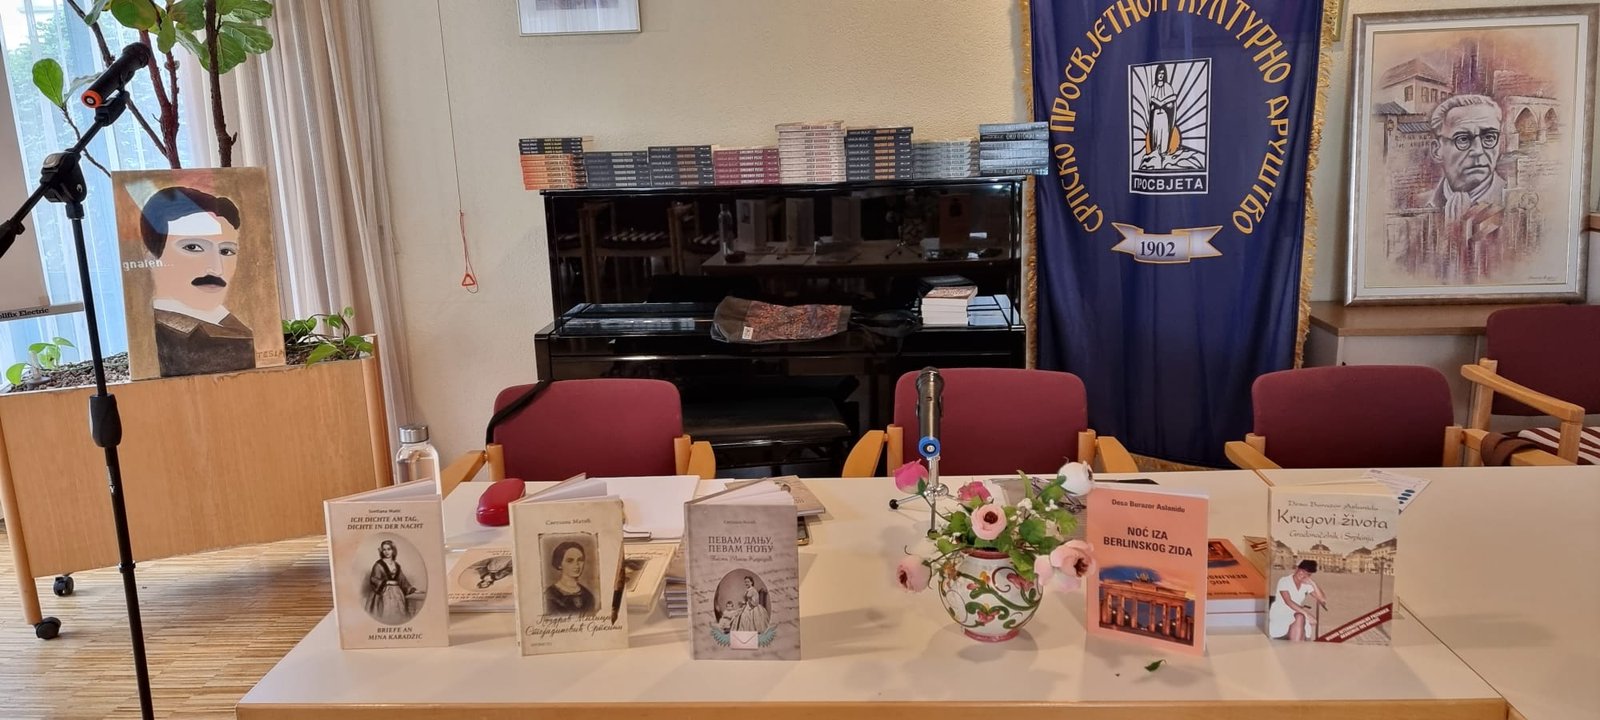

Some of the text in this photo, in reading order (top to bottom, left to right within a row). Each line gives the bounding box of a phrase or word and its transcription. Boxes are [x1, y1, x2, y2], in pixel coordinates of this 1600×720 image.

[1232, 95, 1289, 235] ДРУШТВО
[1054, 143, 1104, 233] СРПСКО
[1133, 177, 1204, 191] ПРОСВЈЕТА
[1139, 241, 1176, 257] 1902
[19, 308, 49, 317] Electric
[1111, 498, 1128, 507] Desa
[1129, 500, 1155, 509] Burazor
[1277, 509, 1388, 529] Krugovi života
[708, 536, 742, 544] ПЕВАМ
[1127, 526, 1168, 540] NOĆ IZA
[708, 544, 774, 553] ПЕВАМ НОЋУ
[1103, 536, 1193, 557] BERLINSKOG ZIDA
